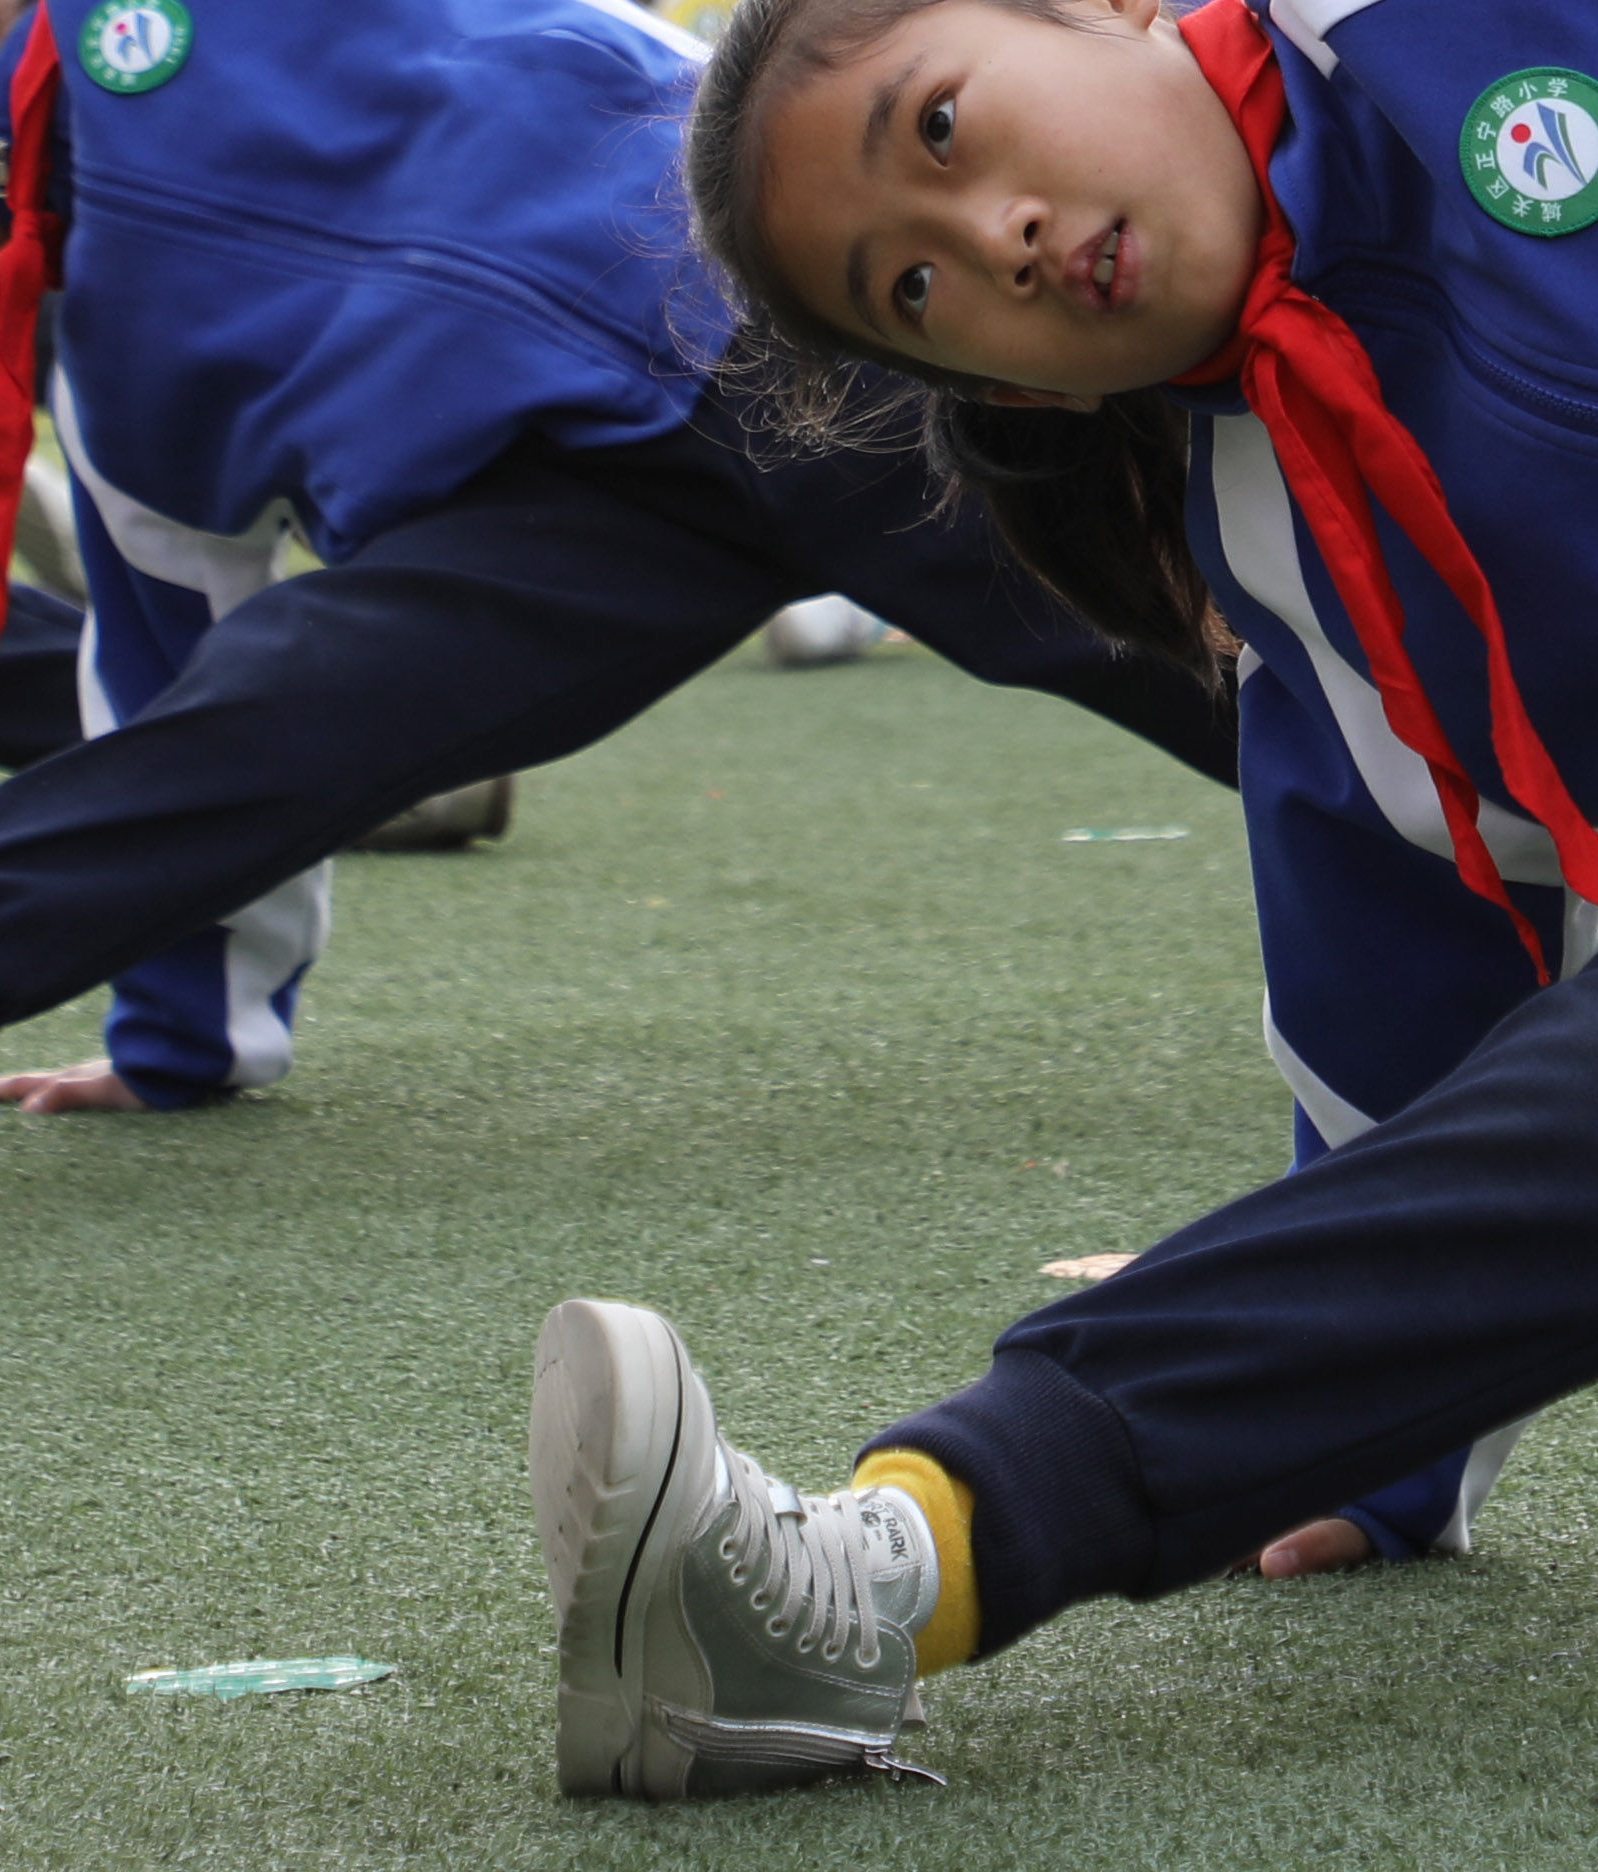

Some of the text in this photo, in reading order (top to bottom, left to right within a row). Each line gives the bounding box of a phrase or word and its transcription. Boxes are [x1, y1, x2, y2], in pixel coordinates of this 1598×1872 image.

[1475, 77, 1570, 223] 城关区正宁路小学
